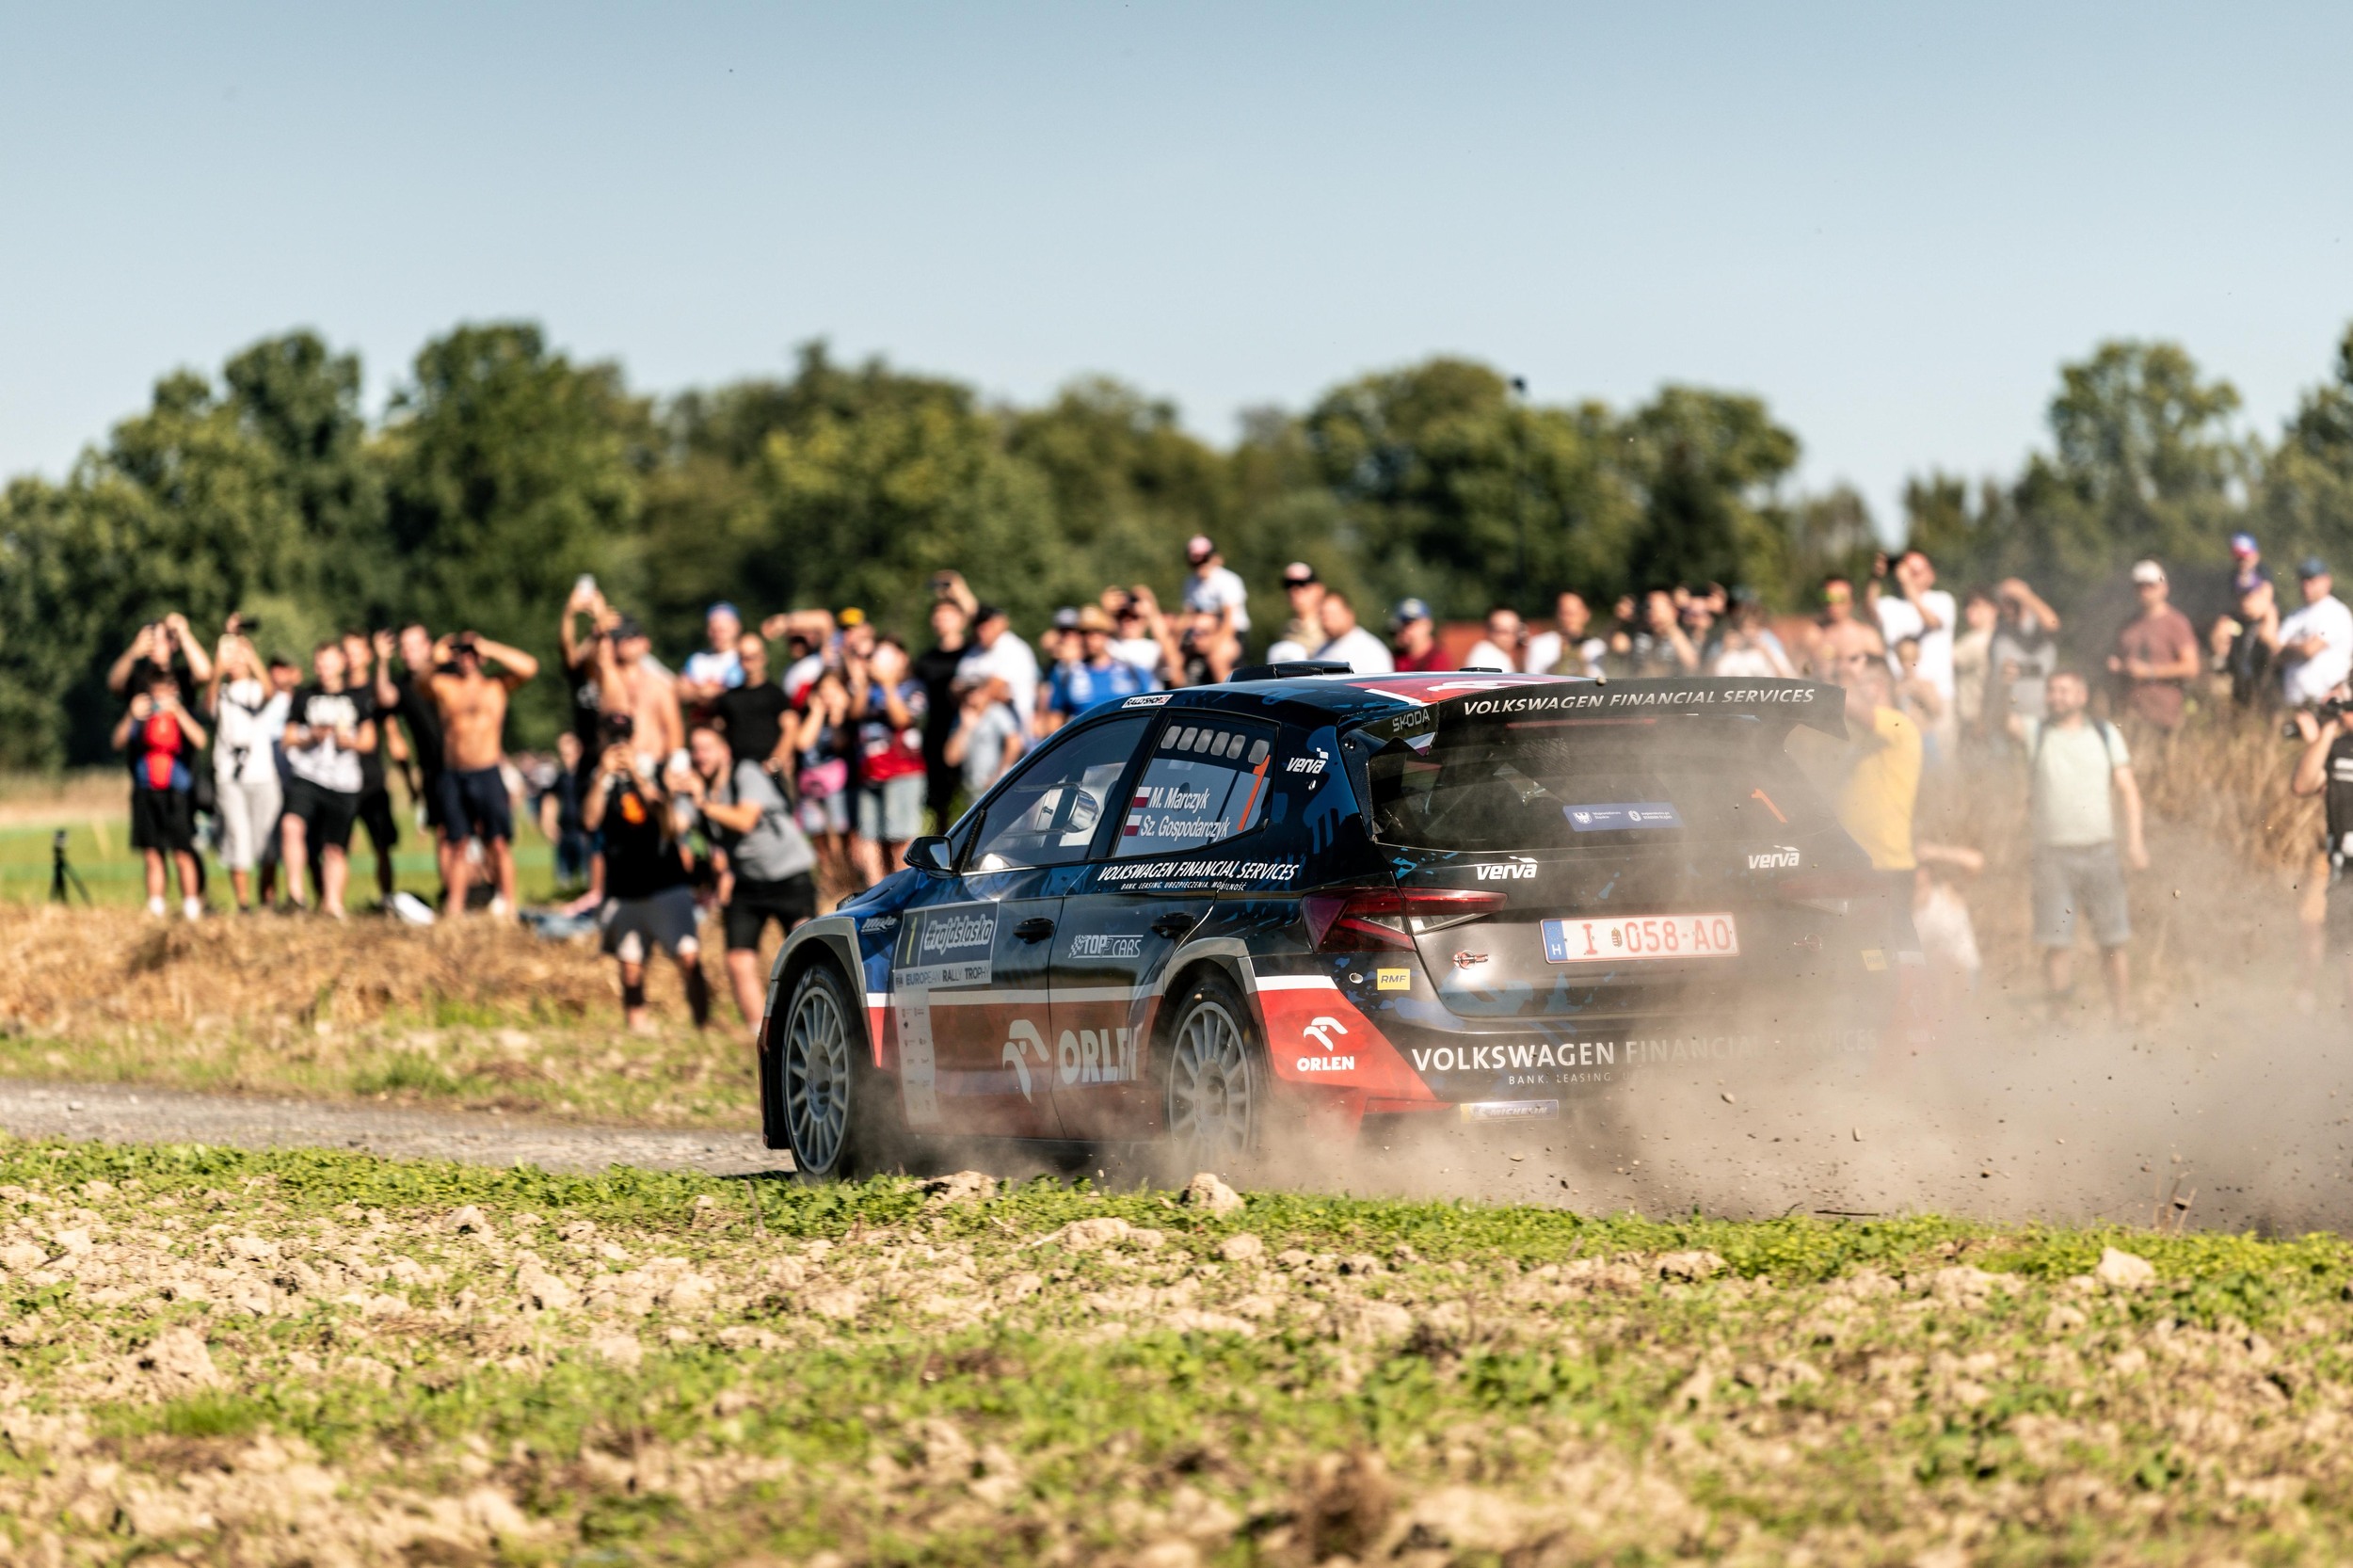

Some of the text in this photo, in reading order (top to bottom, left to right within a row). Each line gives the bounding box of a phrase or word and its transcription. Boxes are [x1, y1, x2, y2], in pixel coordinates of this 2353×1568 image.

[1464, 689, 1815, 715] VOLKSWAGEN FINANCIAL SERVICES
[1287, 754, 1327, 774] verva
[1148, 787, 1210, 813] M. Marczyk
[1238, 755, 1271, 831] 1
[1140, 815, 1230, 841] Sz. Gospodarczyk
[1749, 848, 1800, 869] verva
[1097, 860, 1300, 881] VOLKSWAGEN FINANCIAL SERVICES
[1477, 860, 1538, 880] verva
[905, 917, 918, 965] 1
[925, 915, 994, 955] #rajdslaska
[1582, 923, 1597, 955] I
[1082, 935, 1142, 957] TOP CARS
[1552, 944, 1561, 956] H
[942, 968, 963, 983] RALLY
[1381, 975, 1406, 984] RMF
[1296, 1056, 1354, 1071] ORLEN
[1412, 1042, 1614, 1071] VOLKSWAGEN
[1509, 1075, 1548, 1085] BANK.
[1557, 1072, 1613, 1083] LEASING.
[1491, 1107, 1548, 1116] MICHELIN
